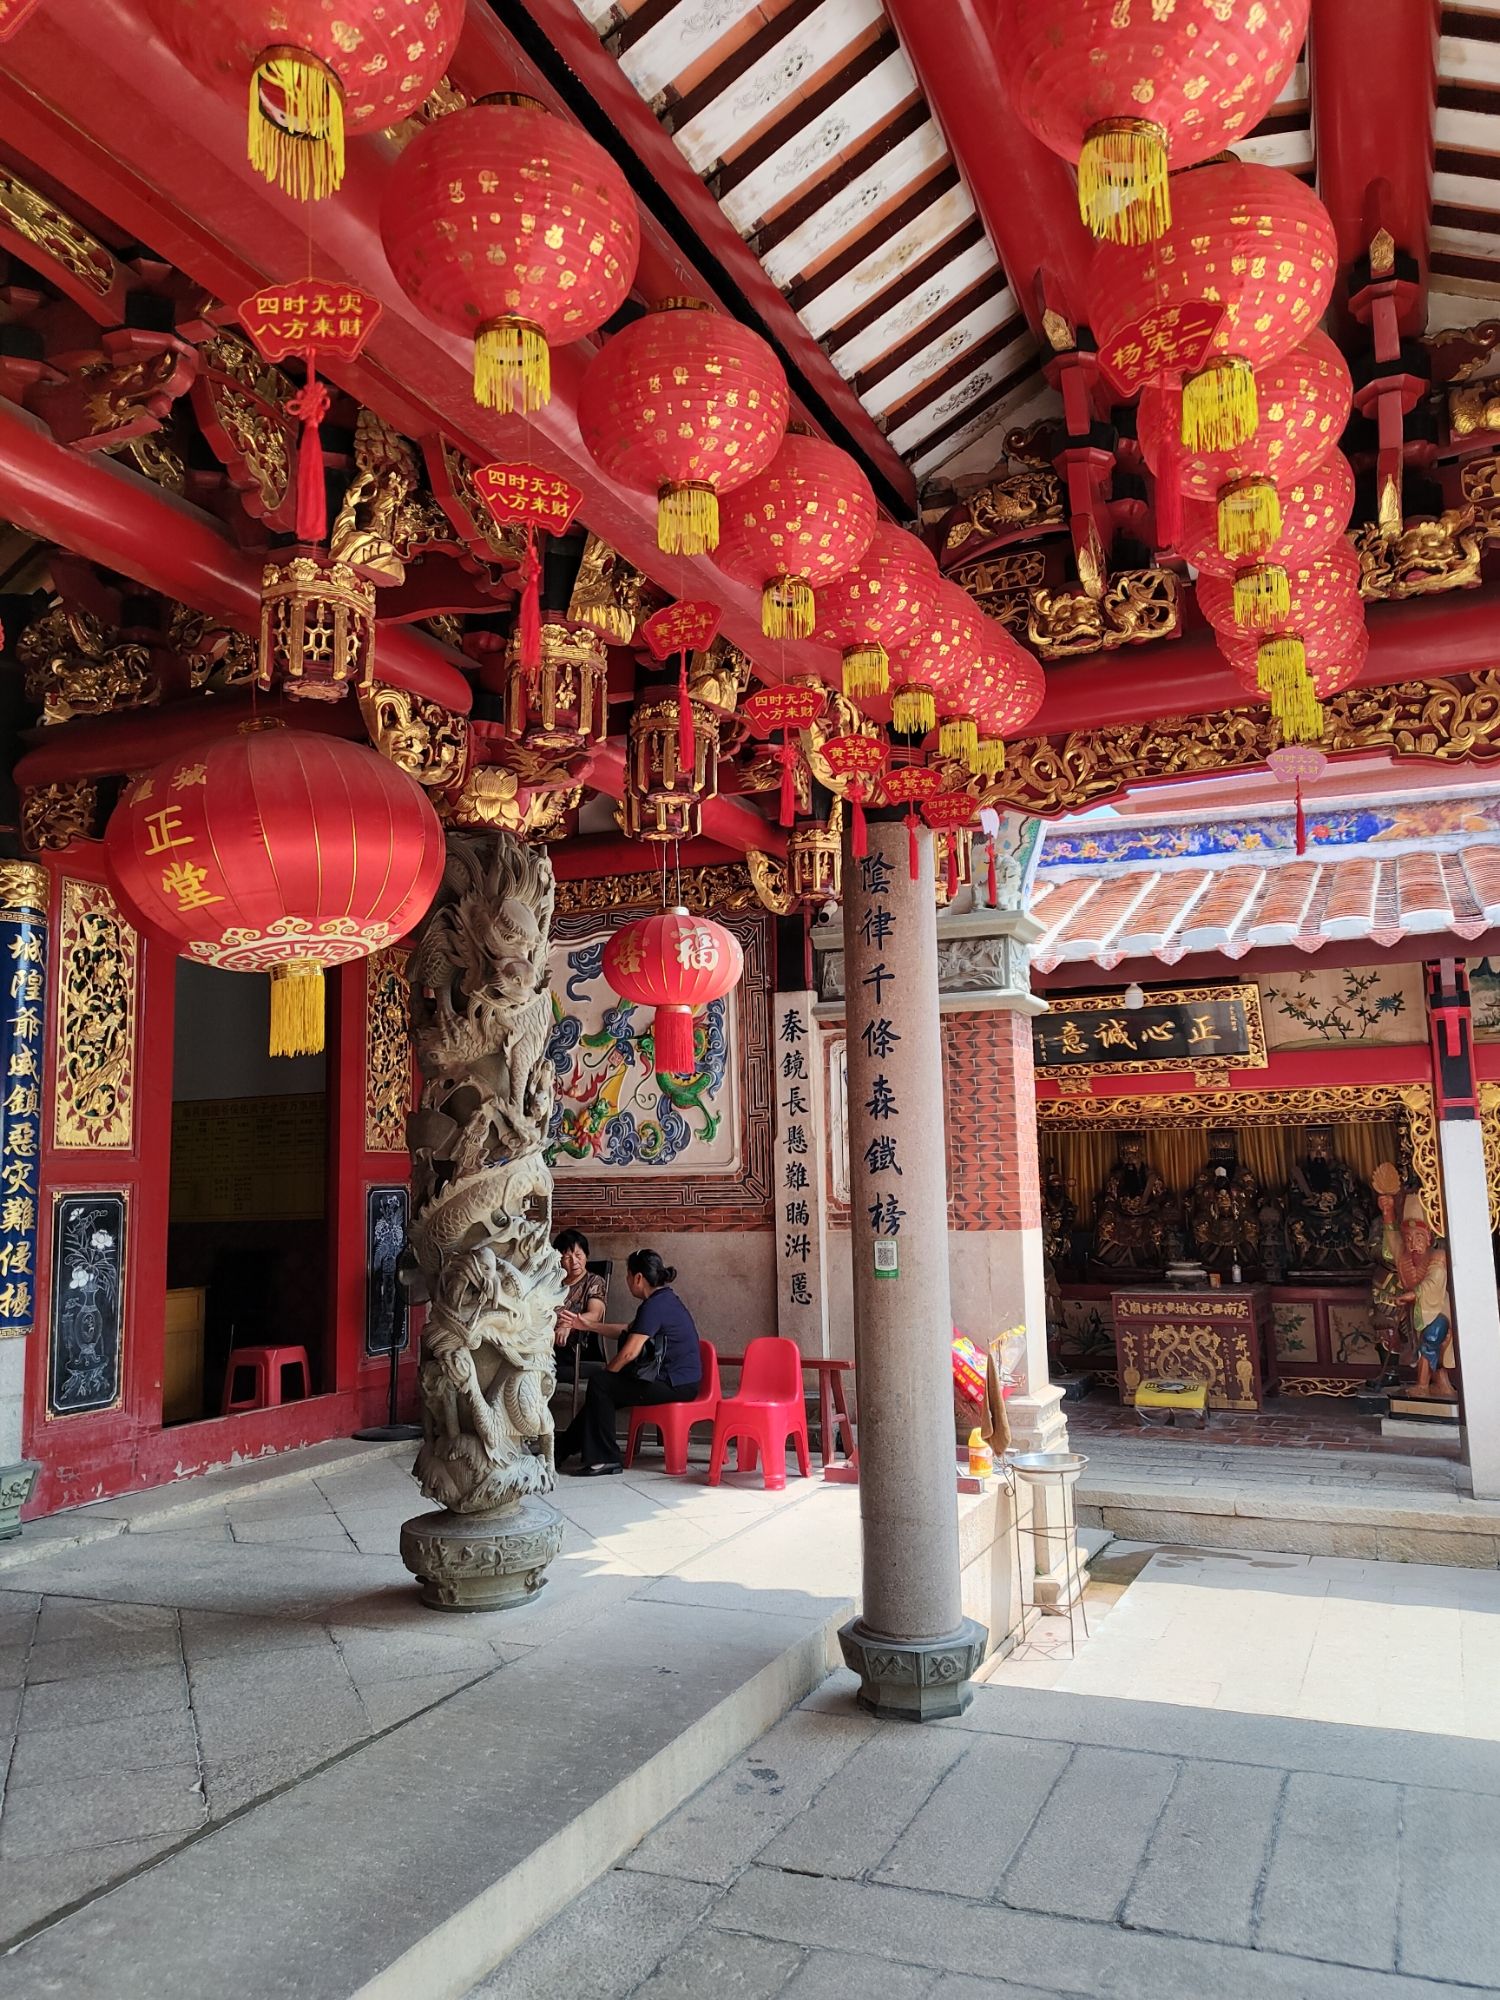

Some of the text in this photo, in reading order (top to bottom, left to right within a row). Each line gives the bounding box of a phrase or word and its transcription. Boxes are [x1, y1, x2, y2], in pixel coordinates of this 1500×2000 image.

[256, 294, 363, 315] 四时无灾
[254, 318, 363, 339] 八方来财
[1139, 308, 1181, 337] 台湾
[1111, 320, 1213, 370] 杨宪二
[1123, 343, 1200, 379] 合家平安
[488, 470, 570, 499] 四时无灾
[487, 492, 570, 517] 八方来财
[755, 691, 814, 707] 四时无灾
[754, 705, 814, 720] 八方来财
[843, 738, 867, 748] 金鸡
[835, 759, 877, 767] 合家平安
[1273, 764, 1319, 775] 八方来财
[928, 797, 971, 809] 四时无灾
[928, 807, 971, 819] 八方来财
[676, 926, 719, 971] 福
[1054, 1015, 1222, 1055] 正心誠意
